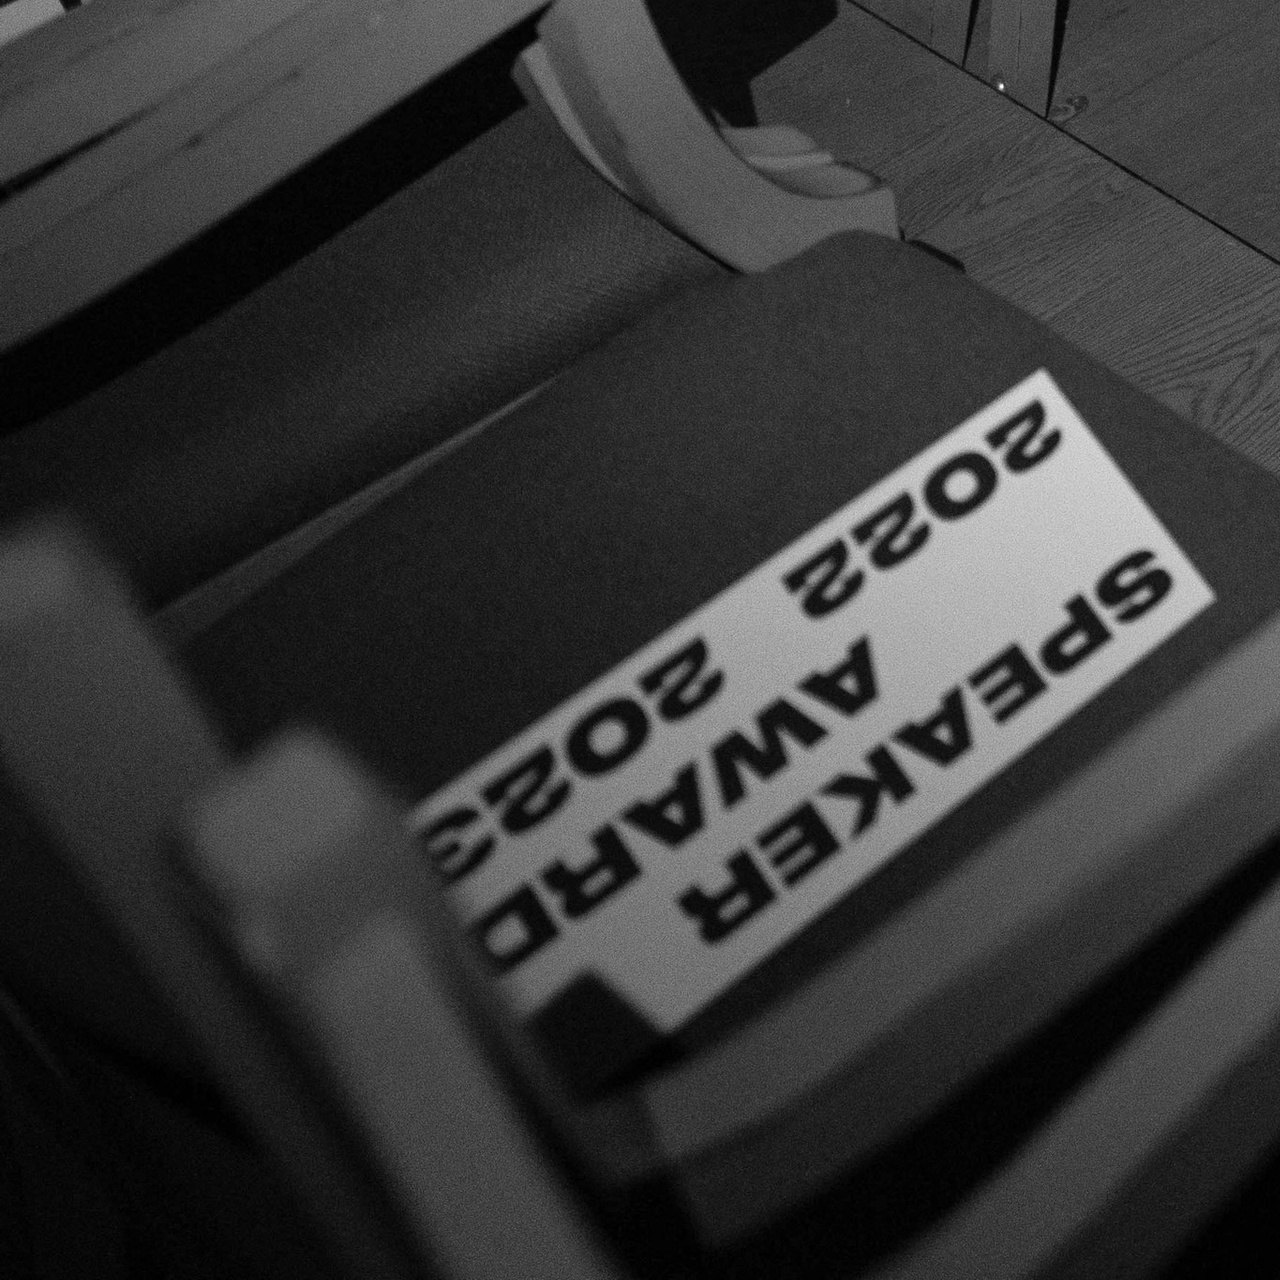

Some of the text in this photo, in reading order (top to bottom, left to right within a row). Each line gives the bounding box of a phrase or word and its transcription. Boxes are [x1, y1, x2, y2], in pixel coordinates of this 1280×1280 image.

[424, 396, 1065, 888] 2022 2023
[464, 635, 886, 980] AWARD
[671, 547, 1178, 950] SPEAKER
